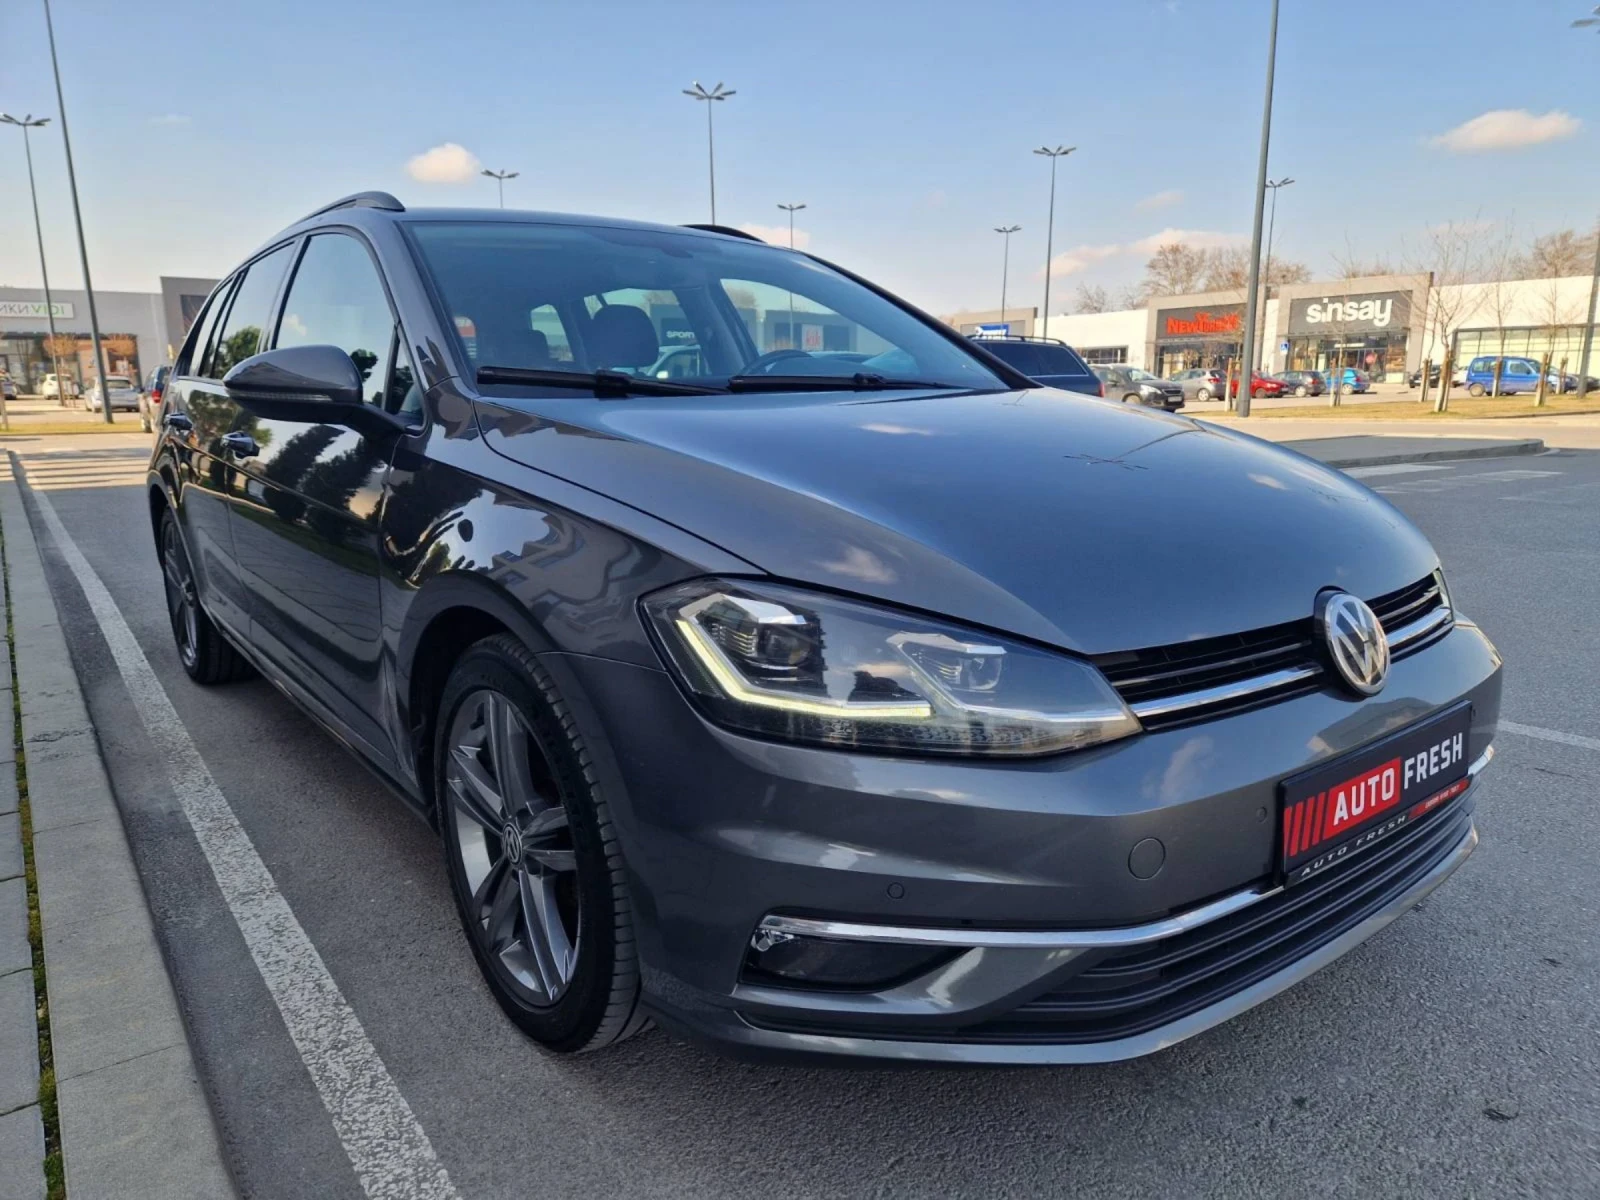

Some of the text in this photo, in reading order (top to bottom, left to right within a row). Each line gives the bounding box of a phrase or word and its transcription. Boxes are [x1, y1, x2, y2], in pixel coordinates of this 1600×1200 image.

[1306, 298, 1392, 327] sinsay
[1333, 767, 1395, 826] AUTO
[1403, 732, 1463, 790] FRESH
[1301, 815, 1406, 877] AUTO FRESH
